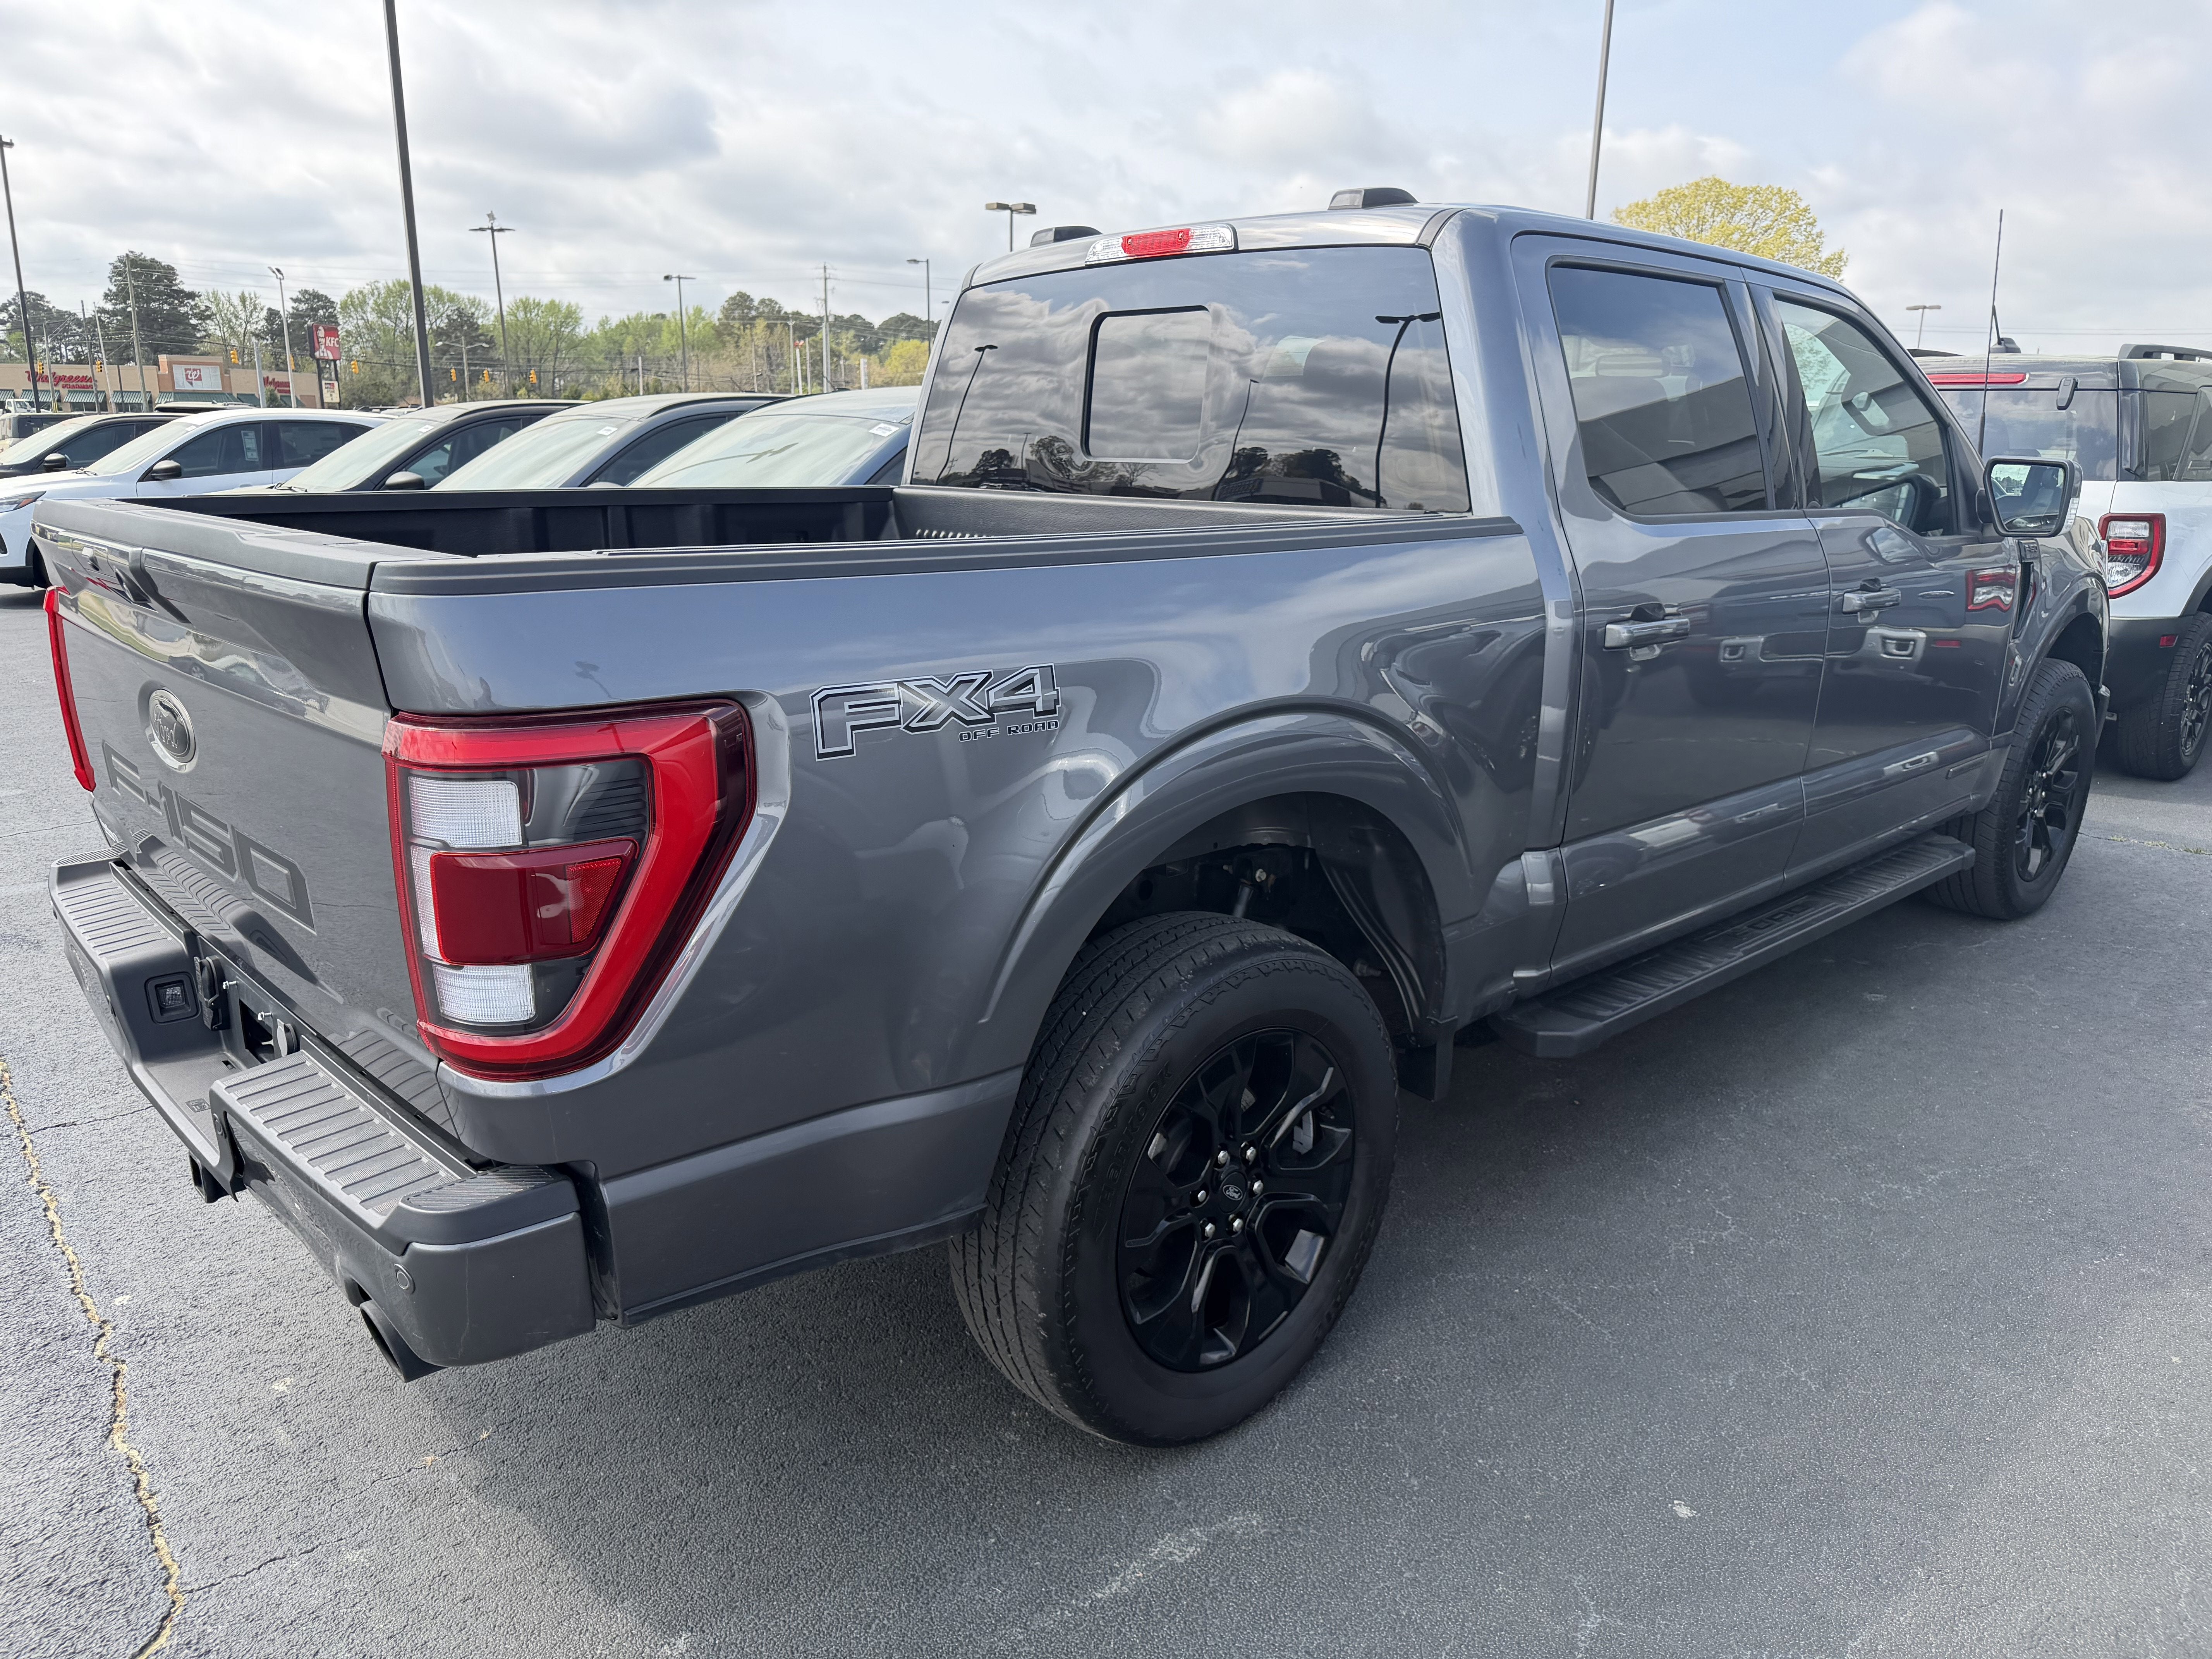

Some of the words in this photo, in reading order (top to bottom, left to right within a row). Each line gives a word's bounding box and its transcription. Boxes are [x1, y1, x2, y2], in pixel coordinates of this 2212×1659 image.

[326, 336, 339, 347] KFC
[153, 703, 179, 749] Ford
[809, 663, 1061, 762] FX4
[958, 727, 1000, 742] OFF
[1007, 720, 1059, 736] ROAD
[102, 739, 317, 936] F-150
[1226, 1186, 1241, 1199] Ford
